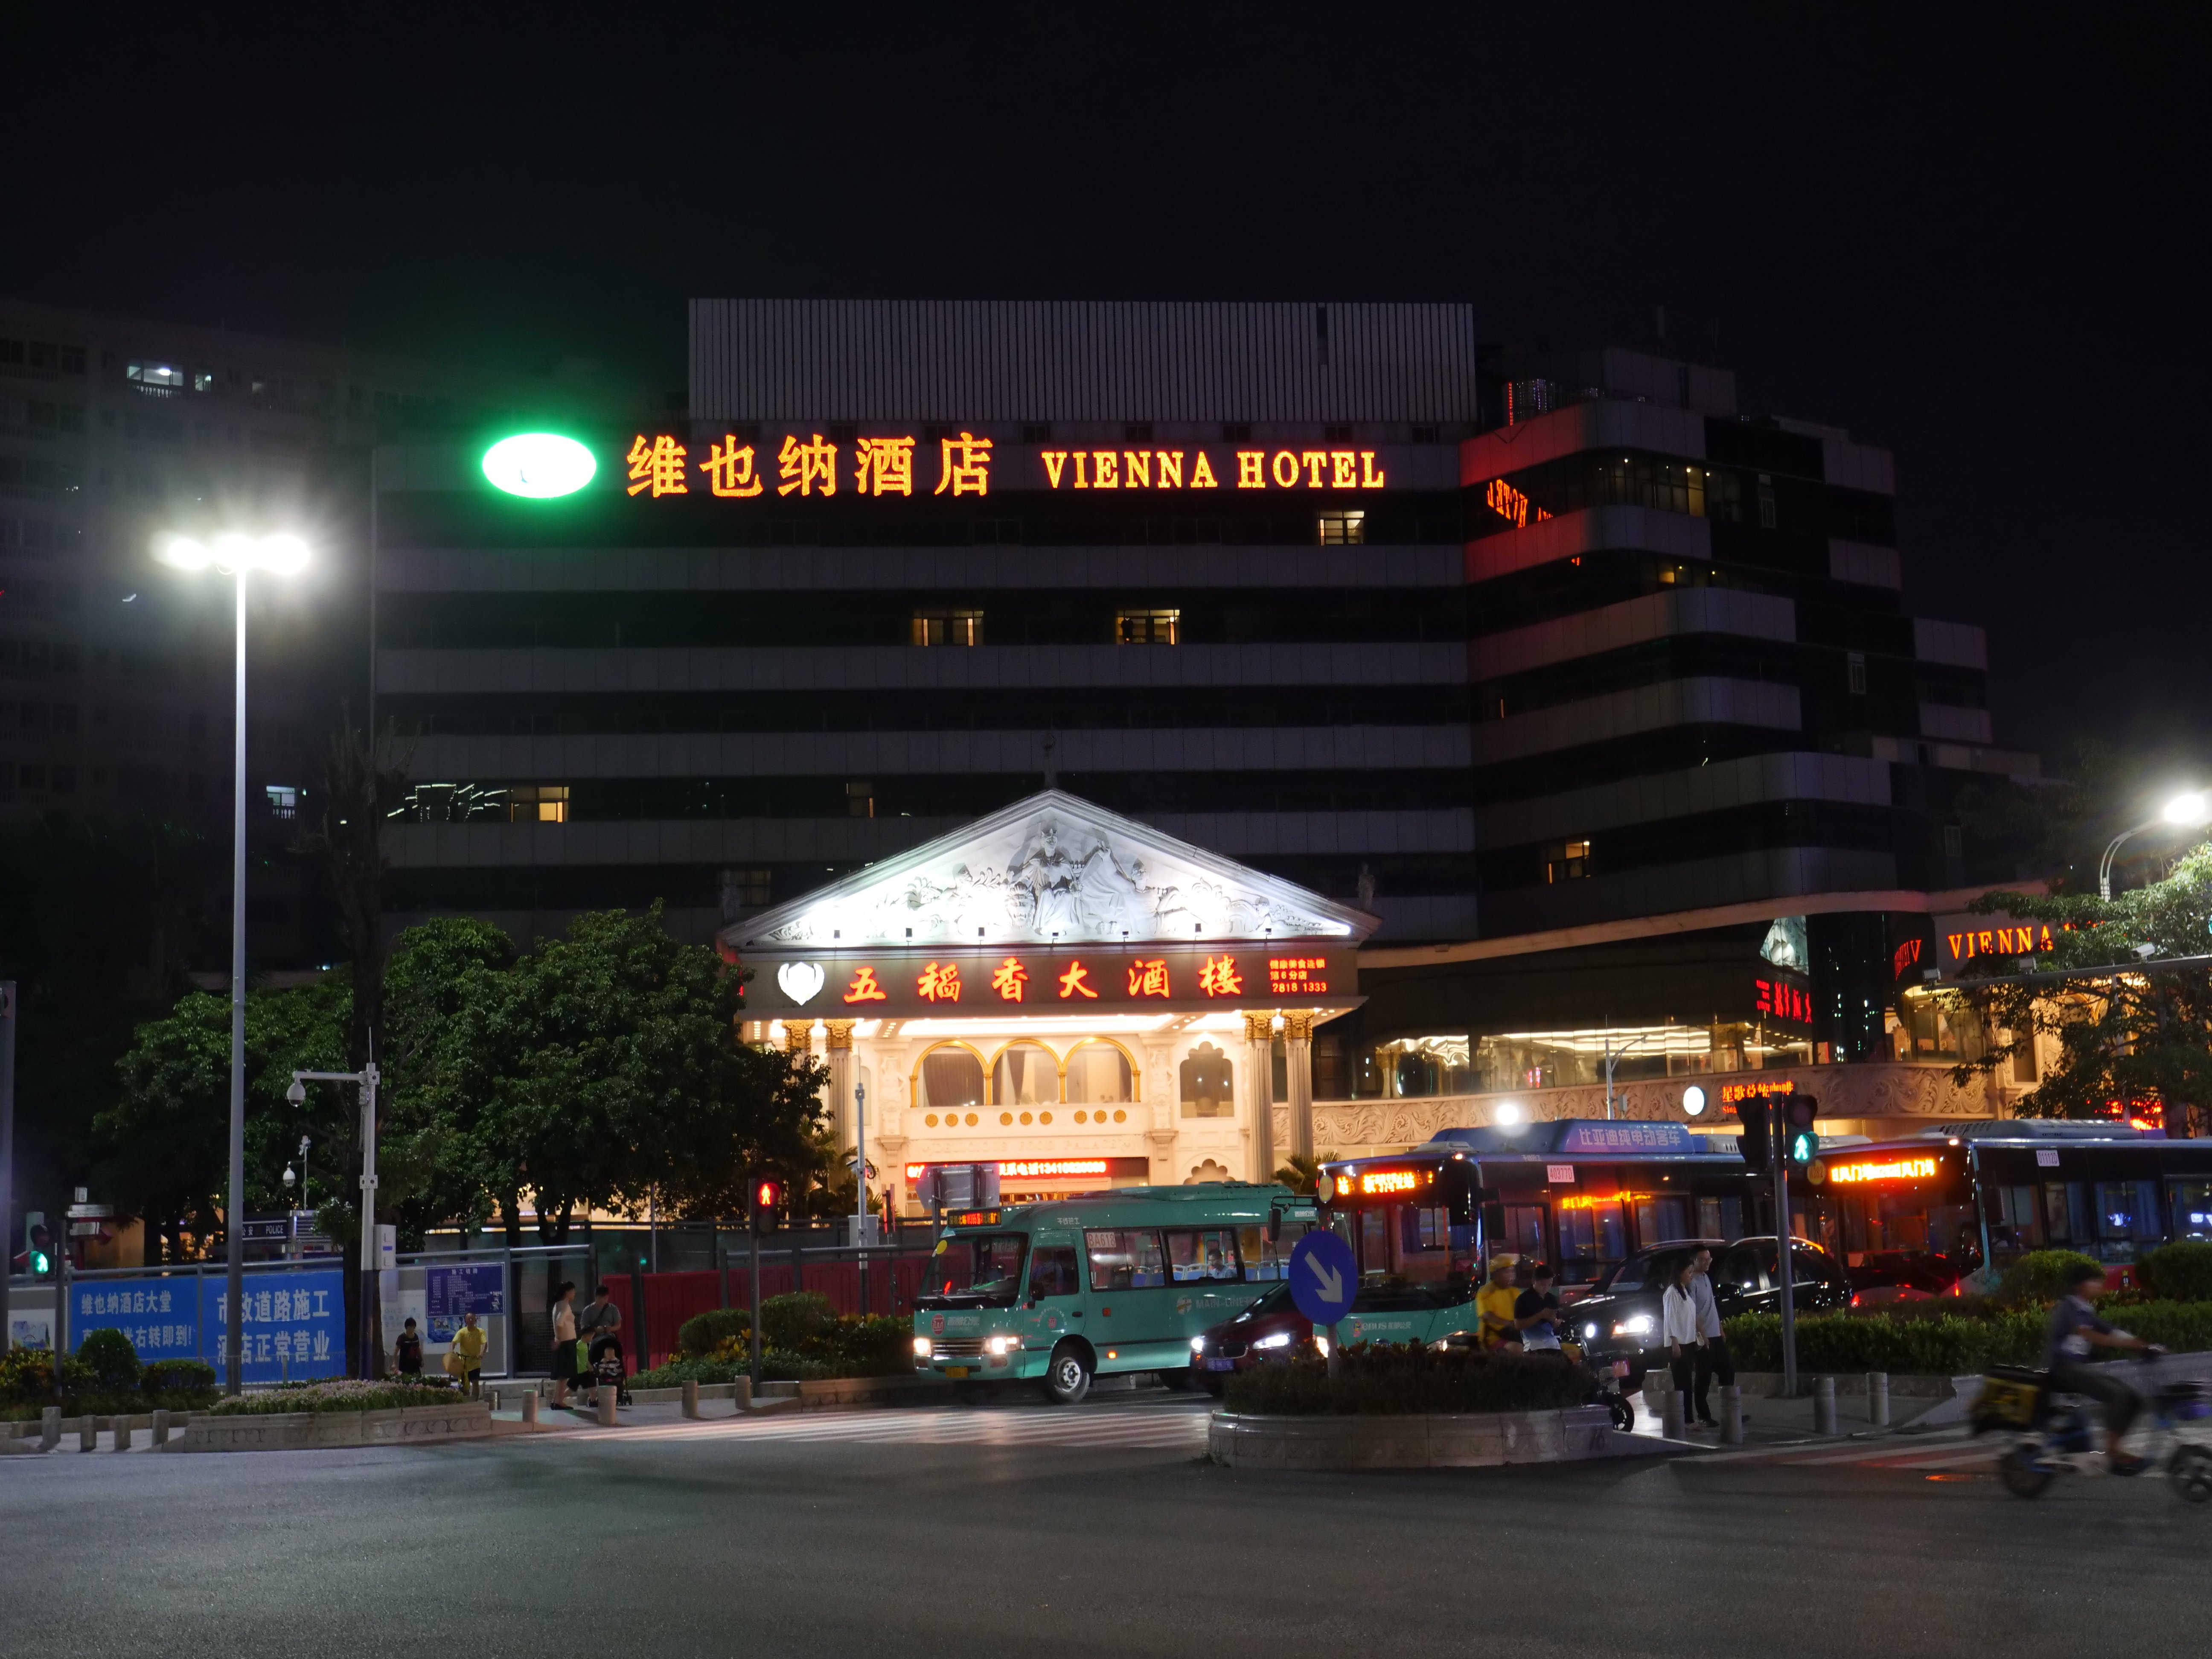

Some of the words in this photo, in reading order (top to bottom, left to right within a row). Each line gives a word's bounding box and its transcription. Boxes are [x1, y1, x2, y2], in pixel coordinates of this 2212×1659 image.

[626, 431, 993, 498] 维也纳酒店
[1040, 449, 1218, 489] VIENNA
[1235, 449, 1385, 489] HOTEL
[1947, 924, 2054, 960] VIENNA
[1272, 982, 1298, 993] 2818
[1302, 982, 1327, 992] 1333
[1579, 1129, 1680, 1146] 比亚迪纯电动客车
[266, 1225, 283, 1234] POLICE
[1088, 1234, 1116, 1247] BA618
[81, 1290, 172, 1316] 维也纳酒店大堂
